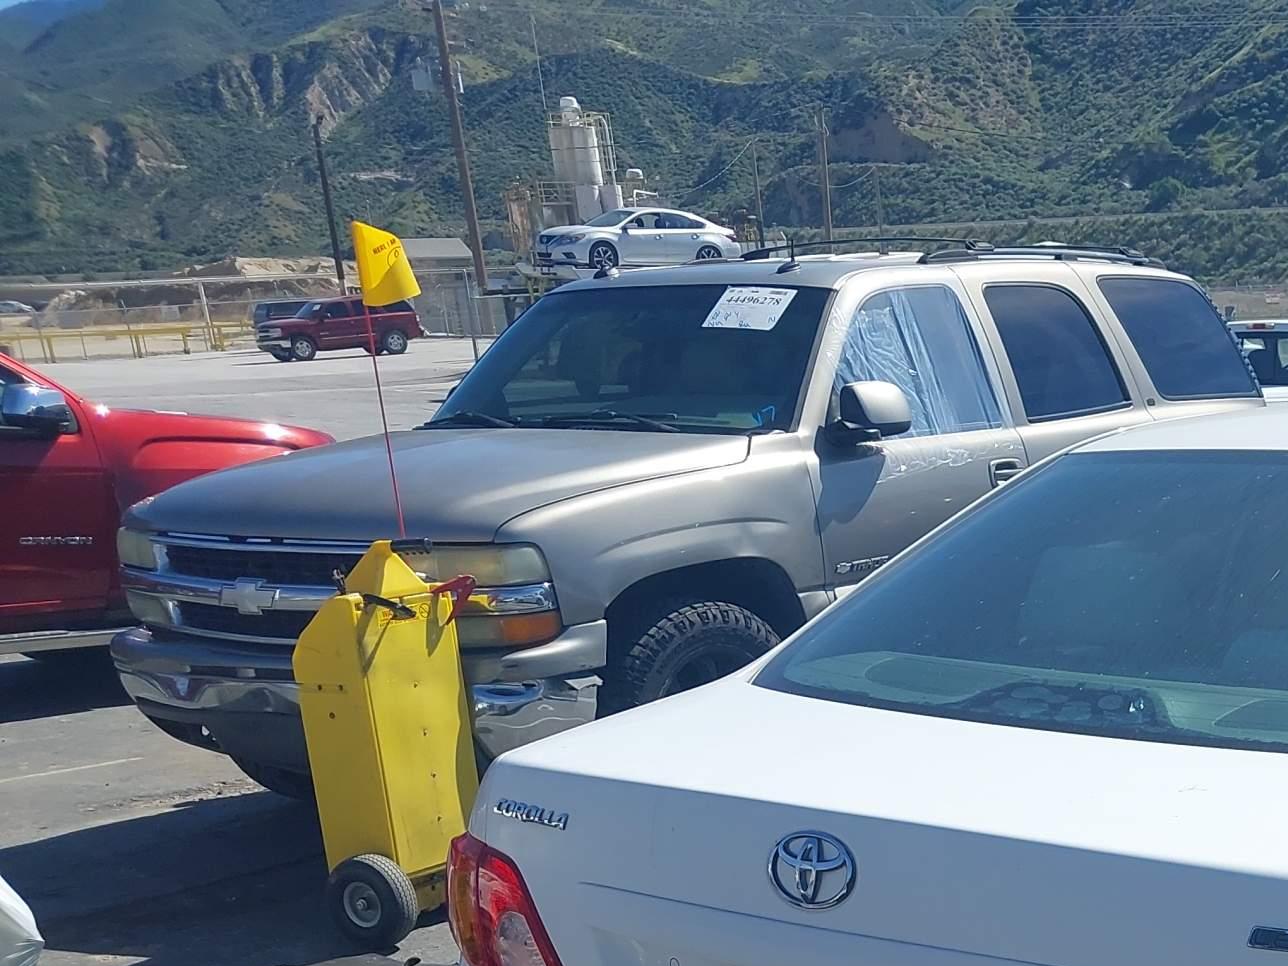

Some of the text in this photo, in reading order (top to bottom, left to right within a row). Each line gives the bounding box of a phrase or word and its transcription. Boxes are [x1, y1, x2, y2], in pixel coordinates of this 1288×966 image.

[725, 295, 783, 306] 44496278
[19, 536, 93, 545] CANYON
[493, 797, 570, 831] COROLLA
